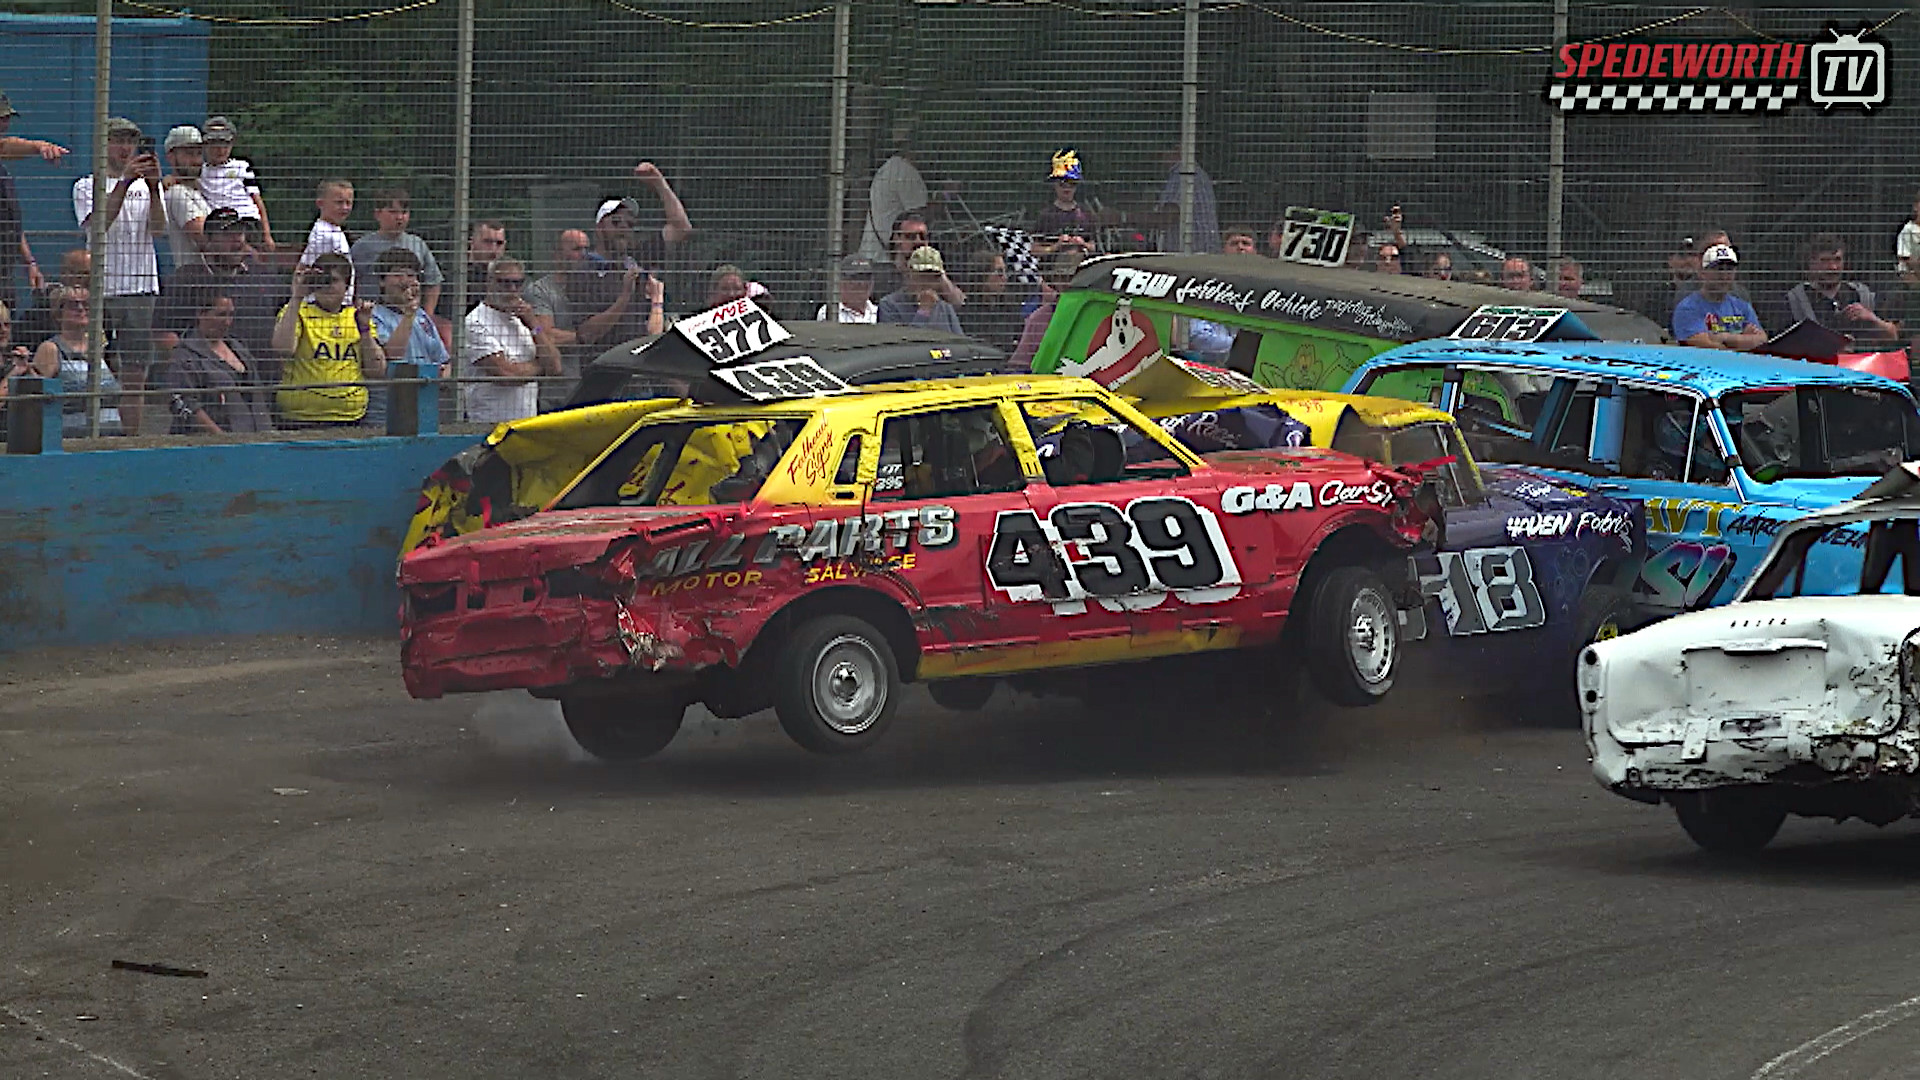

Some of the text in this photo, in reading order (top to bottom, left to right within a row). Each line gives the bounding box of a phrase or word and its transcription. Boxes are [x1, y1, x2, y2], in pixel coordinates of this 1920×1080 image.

[1284, 222, 1349, 262] 730
[1111, 267, 1178, 298] TBW
[713, 300, 748, 324] NYE
[1458, 314, 1550, 340] 613
[696, 310, 773, 361] 377
[314, 342, 358, 362] AIA
[732, 362, 846, 396] 439
[1222, 481, 1313, 513] G&A
[752, 504, 957, 564] PARTS
[1507, 511, 1572, 541] HAVEN
[986, 496, 1240, 611] 439
[651, 570, 764, 598] MOTOR
